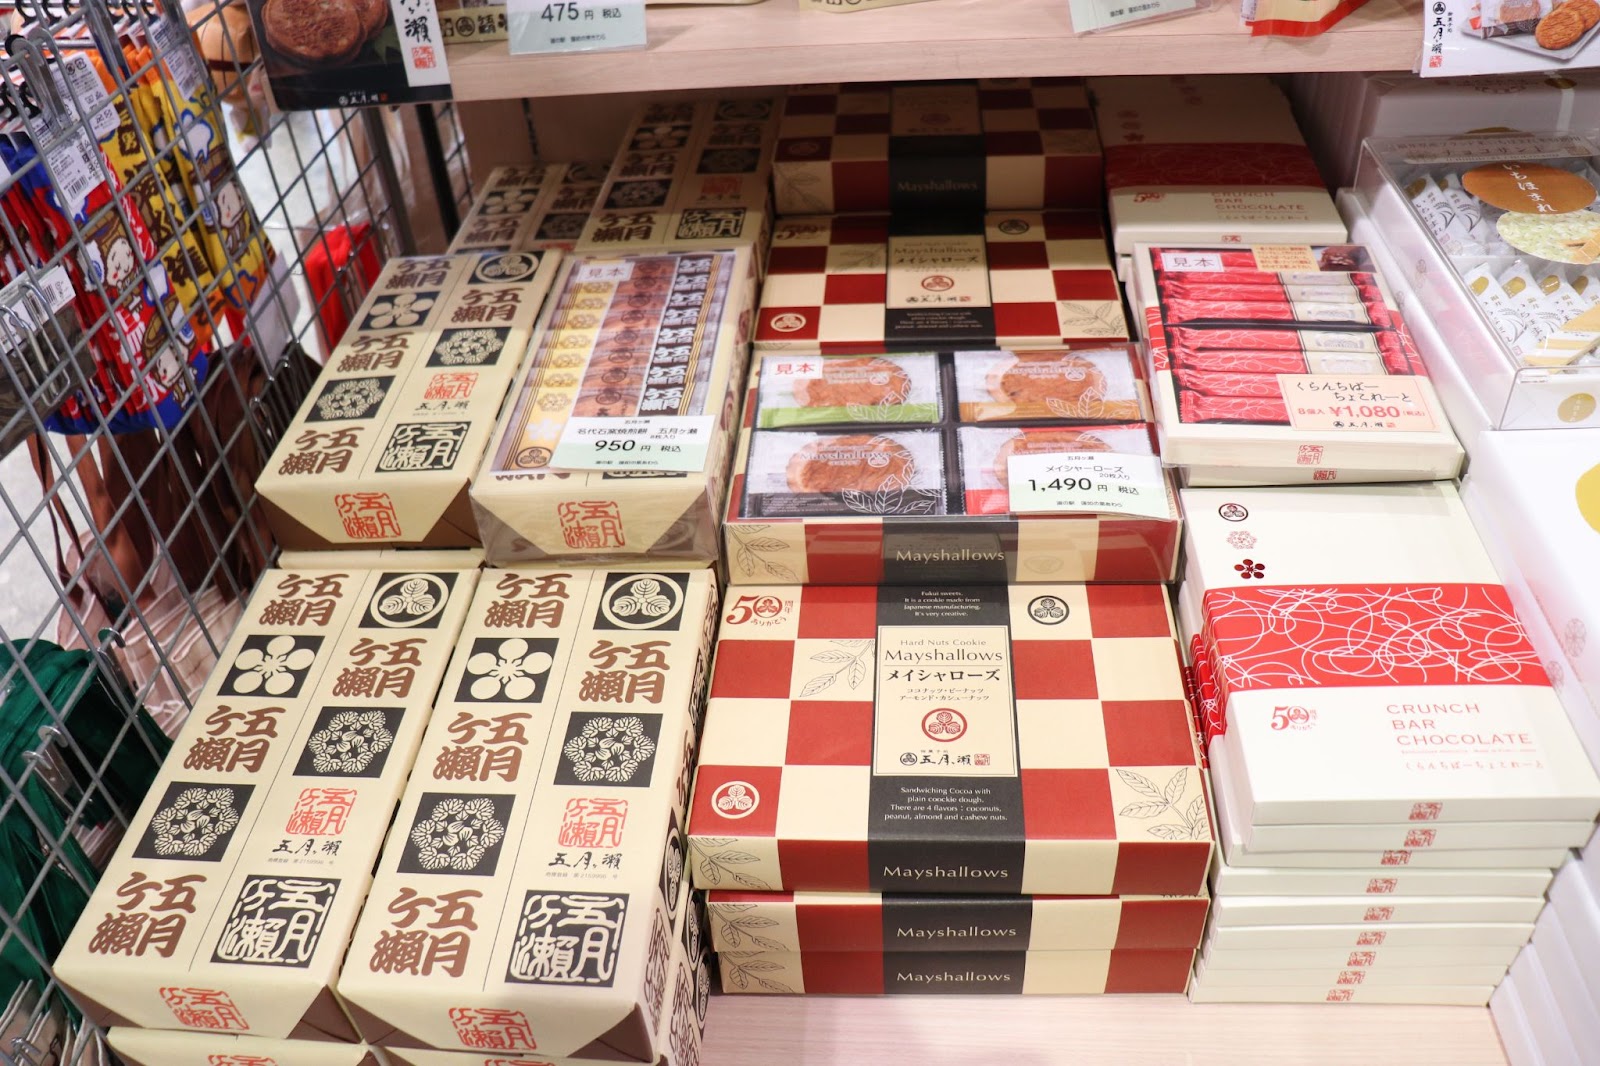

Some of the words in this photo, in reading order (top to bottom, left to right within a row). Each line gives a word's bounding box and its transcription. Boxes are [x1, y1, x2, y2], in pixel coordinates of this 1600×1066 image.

[541, 2, 579, 21] 475
[584, 9, 594, 20] 円
[1502, 164, 1558, 213] いちほまれ
[1173, 257, 1215, 268] 見本
[775, 363, 816, 375] 見本
[1297, 382, 1379, 392] くらんちばー
[1334, 392, 1412, 403] ちょこれーと
[1328, 406, 1401, 418] ¥1,080
[594, 439, 636, 452] 950
[660, 445, 682, 453] 税込
[1045, 465, 1125, 473] メイシャーローズ
[1099, 472, 1131, 480] 20枚入り
[1028, 477, 1092, 492] 1,490
[1097, 484, 1108, 492] 円
[1118, 485, 1140, 495] 税込
[896, 549, 1005, 564] Mayshallows
[884, 649, 1003, 664] Mayshallows
[886, 669, 1000, 682] メイシャローズ
[1386, 703, 1481, 715] CRUNCH
[1392, 719, 1436, 730] BAR
[1396, 733, 1533, 746] CHOCOLATE
[900, 787, 948, 795] Sandwiching
[949, 787, 973, 795] Cocoa
[974, 787, 991, 795] with
[907, 796, 927, 804] plain
[958, 796, 985, 804] dough.
[884, 813, 912, 821] peanut,
[914, 813, 942, 821] almond
[943, 813, 958, 821] and
[960, 813, 988, 821] cashew
[883, 865, 1009, 880] Mayshallows
[896, 926, 1017, 940] Mayshallows
[896, 971, 1011, 984] Mayshallows
